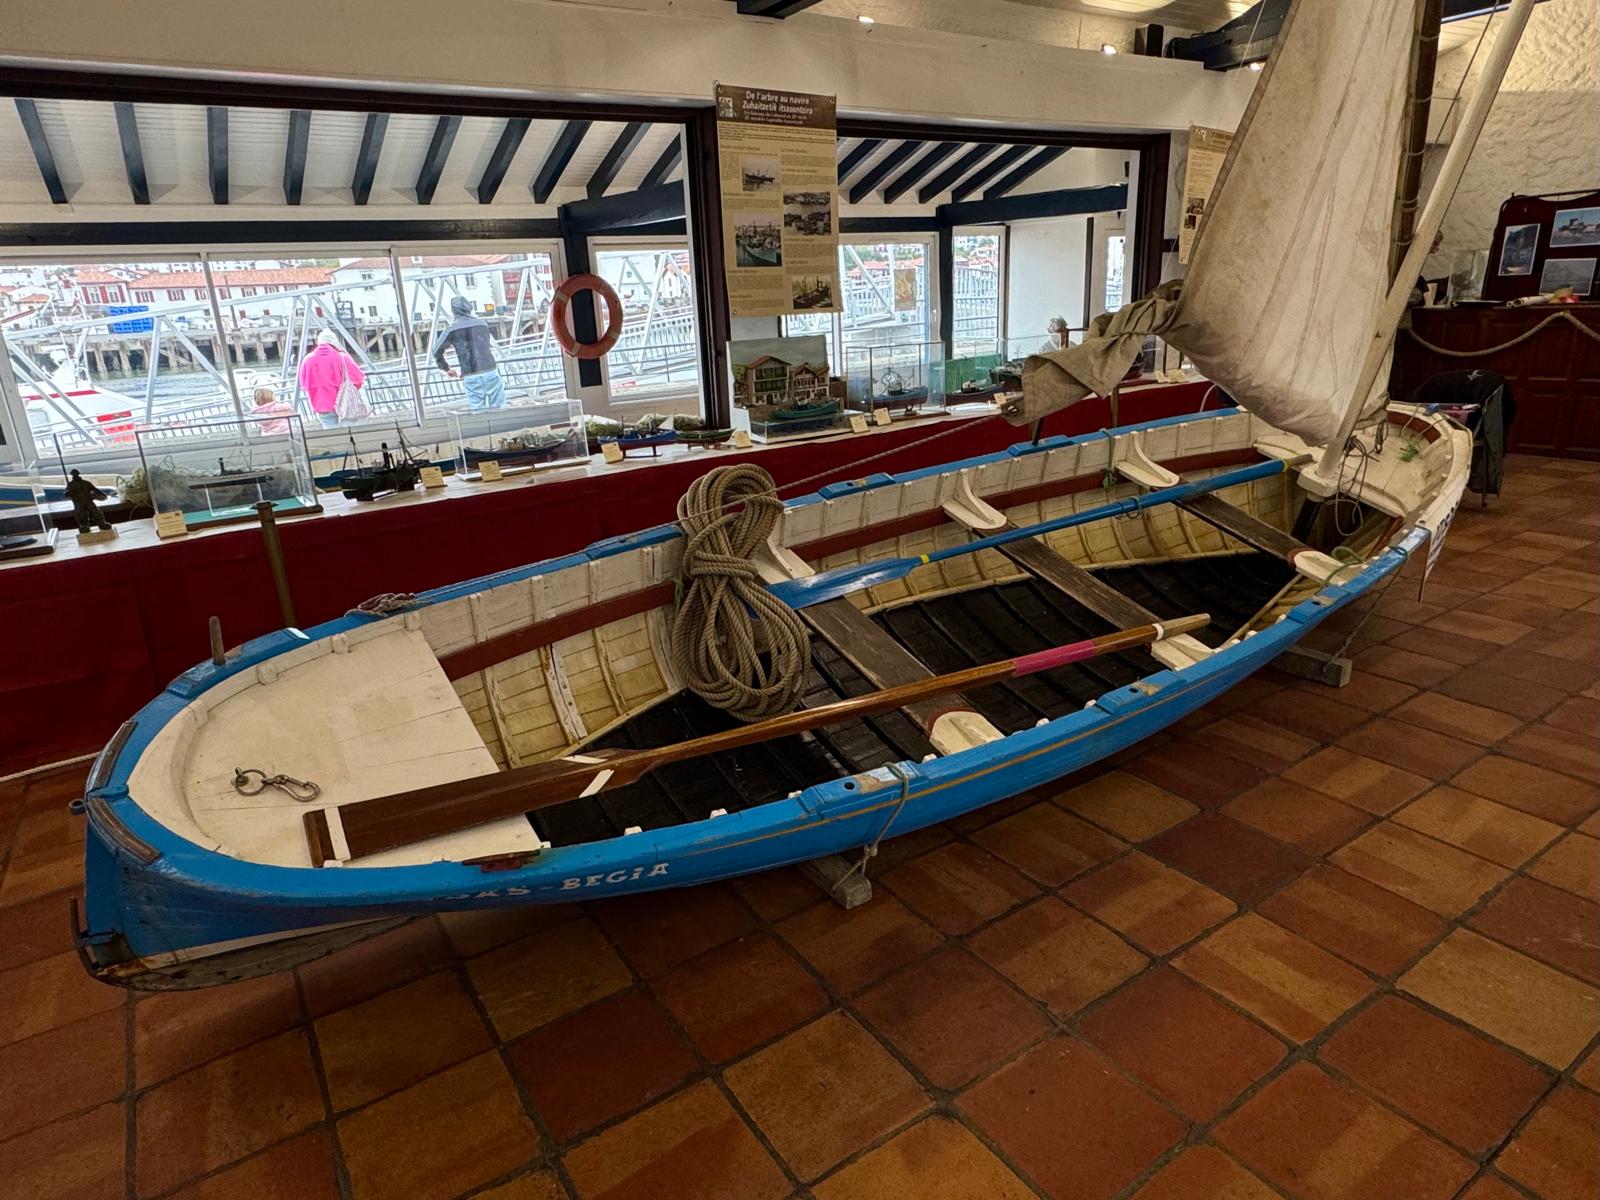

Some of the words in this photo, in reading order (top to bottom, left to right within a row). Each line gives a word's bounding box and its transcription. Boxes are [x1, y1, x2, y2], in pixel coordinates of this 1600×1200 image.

[745, 90, 755, 100] De
[756, 91, 779, 102] l'arbre
[779, 95, 788, 103] au
[789, 96, 810, 105] navire
